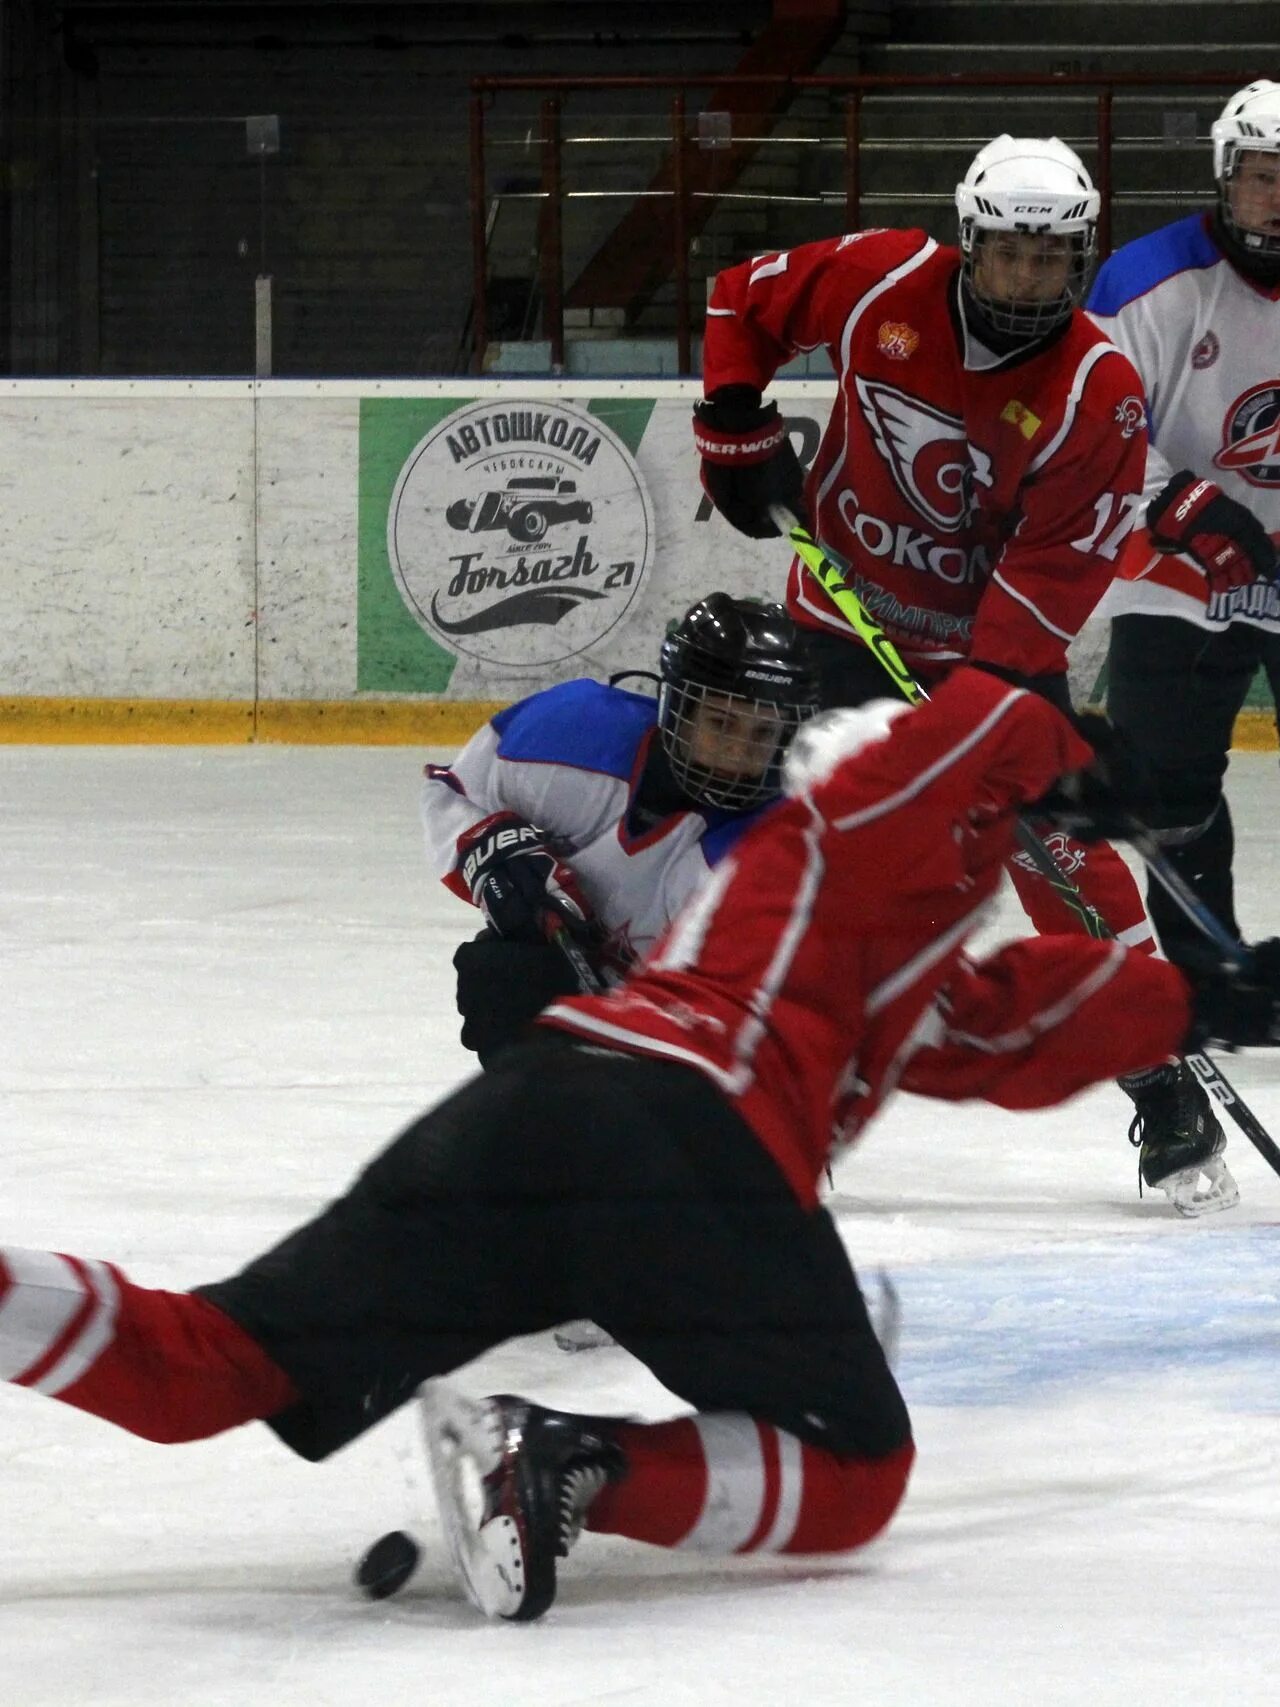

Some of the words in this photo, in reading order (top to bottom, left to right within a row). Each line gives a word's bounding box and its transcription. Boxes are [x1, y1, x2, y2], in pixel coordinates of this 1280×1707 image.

[1014, 206, 1052, 214] CCM
[446, 412, 602, 464] АВТОШКОЛА
[483, 459, 565, 474] ЧЕБОКСАРЫ
[1069, 492, 1141, 561] 17
[448, 535, 600, 597] Forsazh
[603, 562, 636, 589] 21
